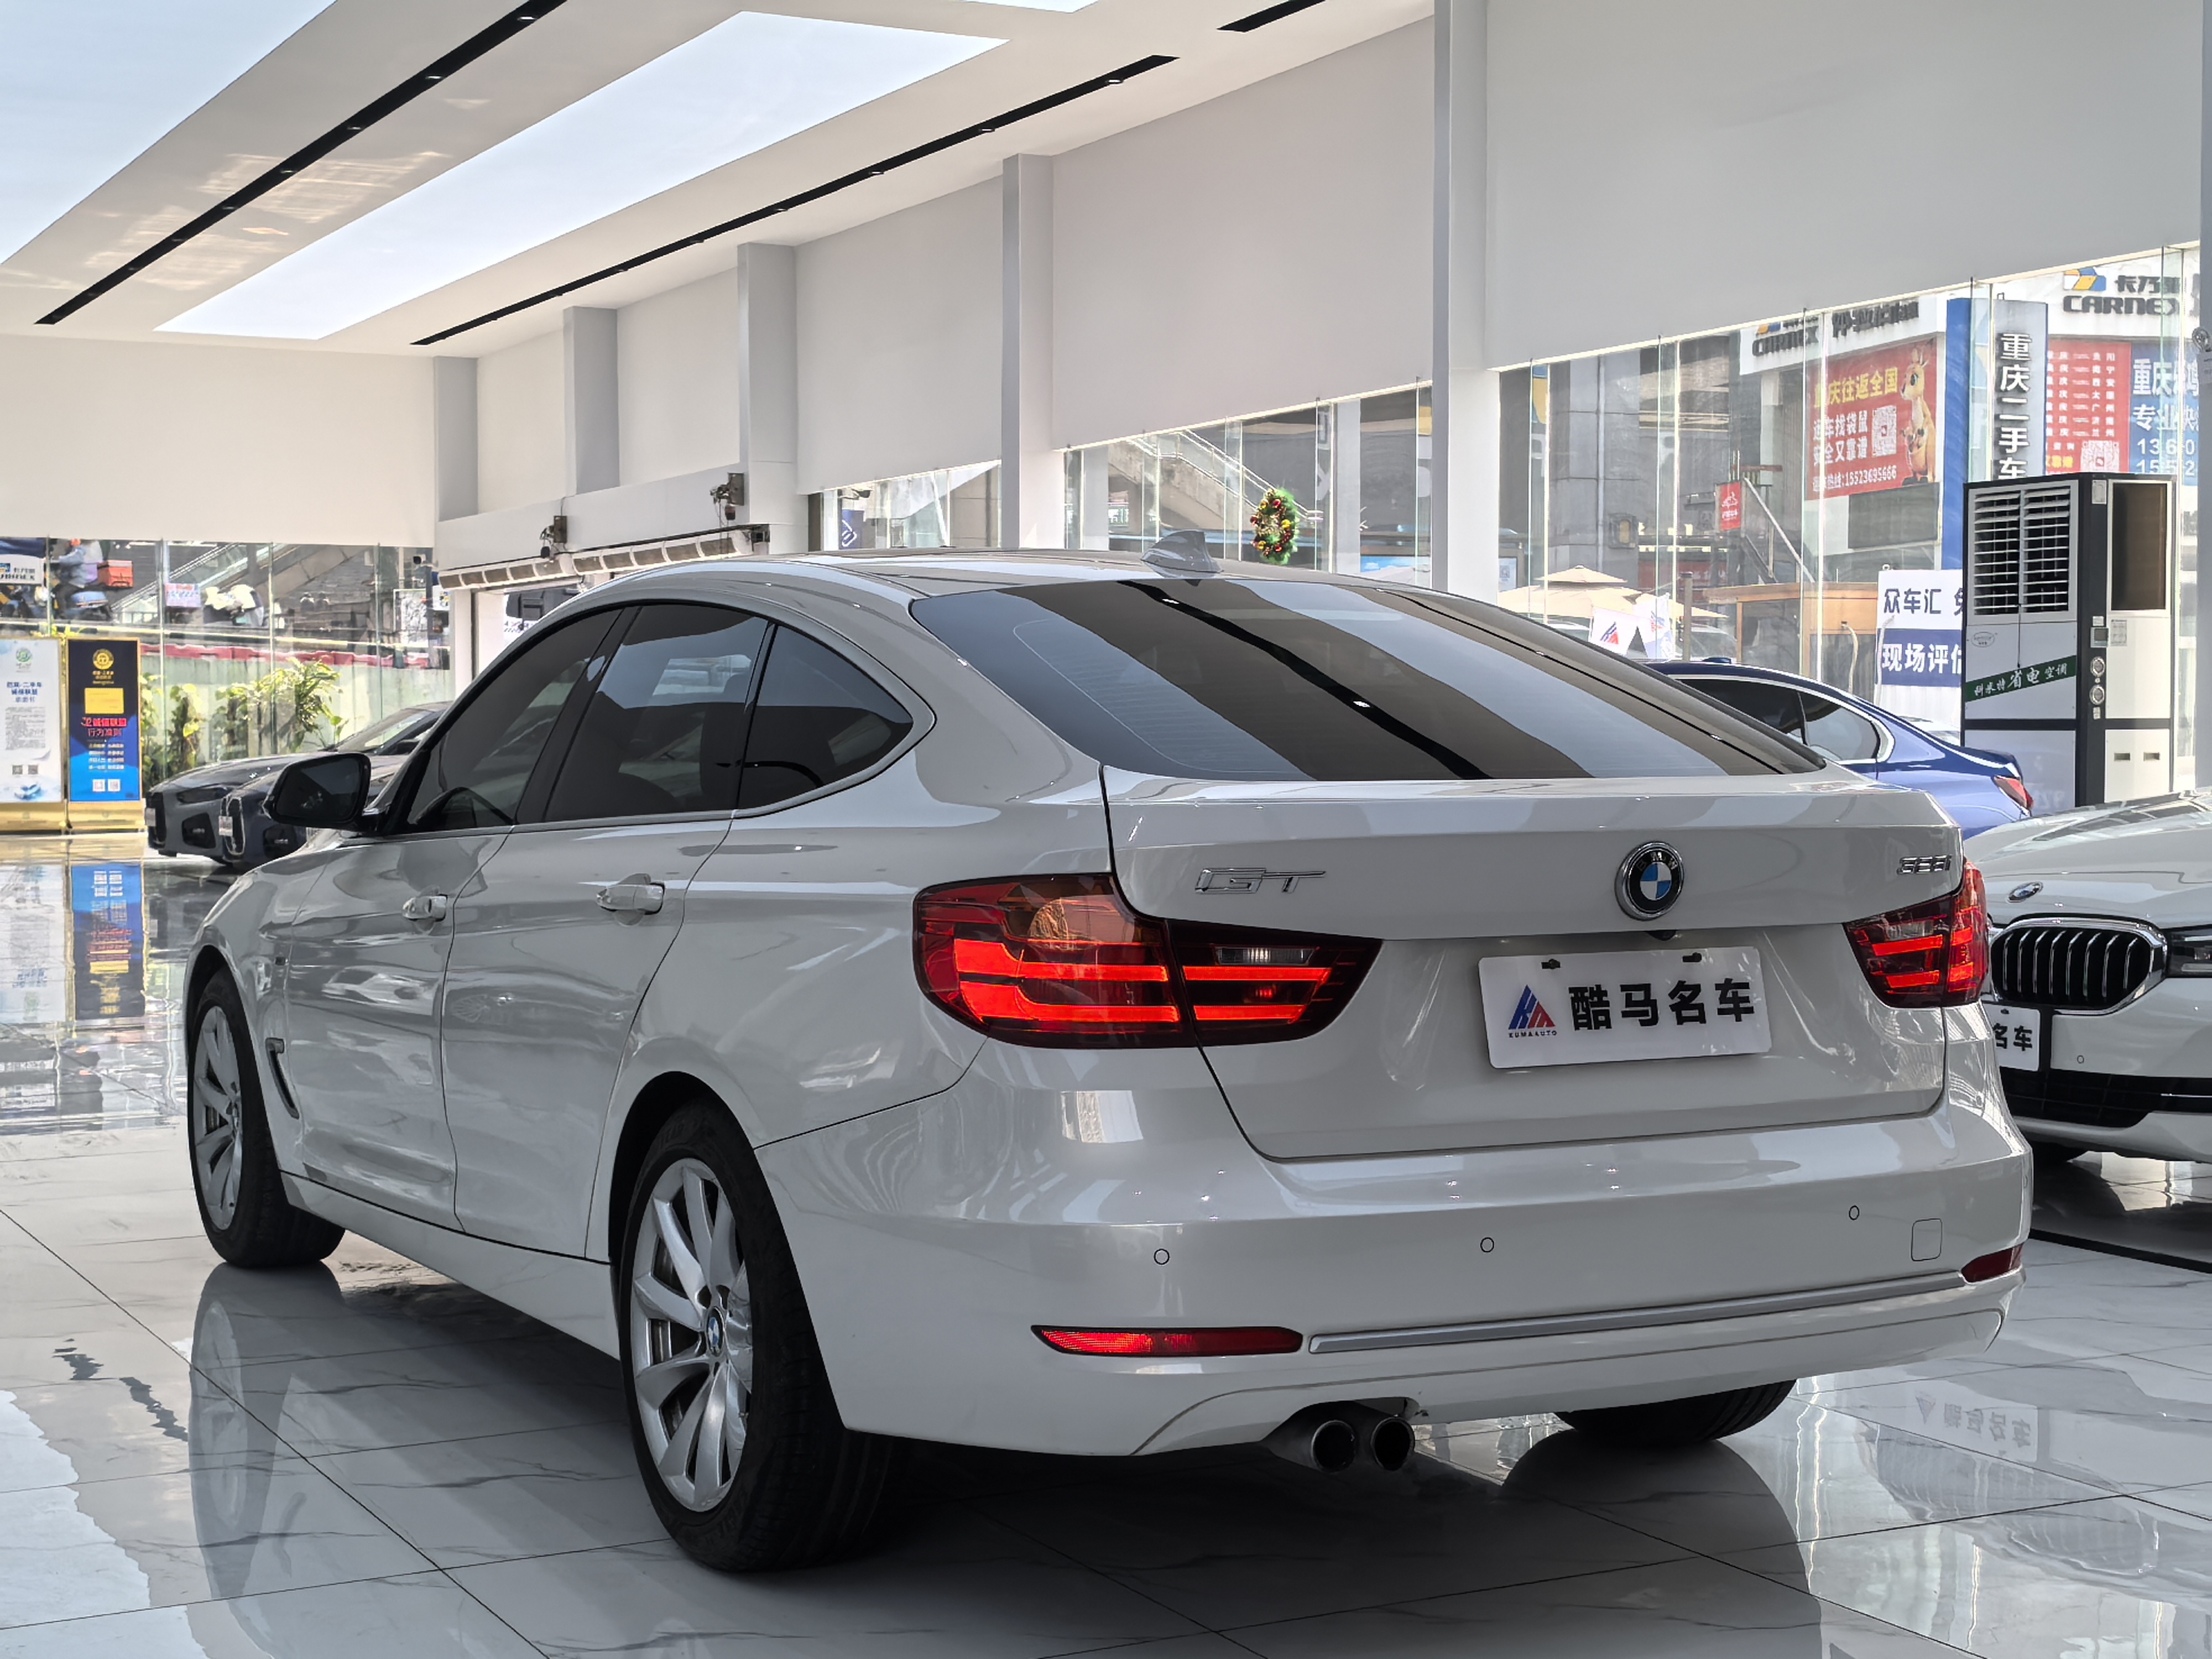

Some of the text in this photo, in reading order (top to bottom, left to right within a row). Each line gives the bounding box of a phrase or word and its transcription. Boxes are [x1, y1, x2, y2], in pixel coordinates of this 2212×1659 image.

[1884, 588, 1942, 614] 众车汇
[1194, 867, 1327, 894] GT
[1568, 978, 1755, 1032] 酷马名车
